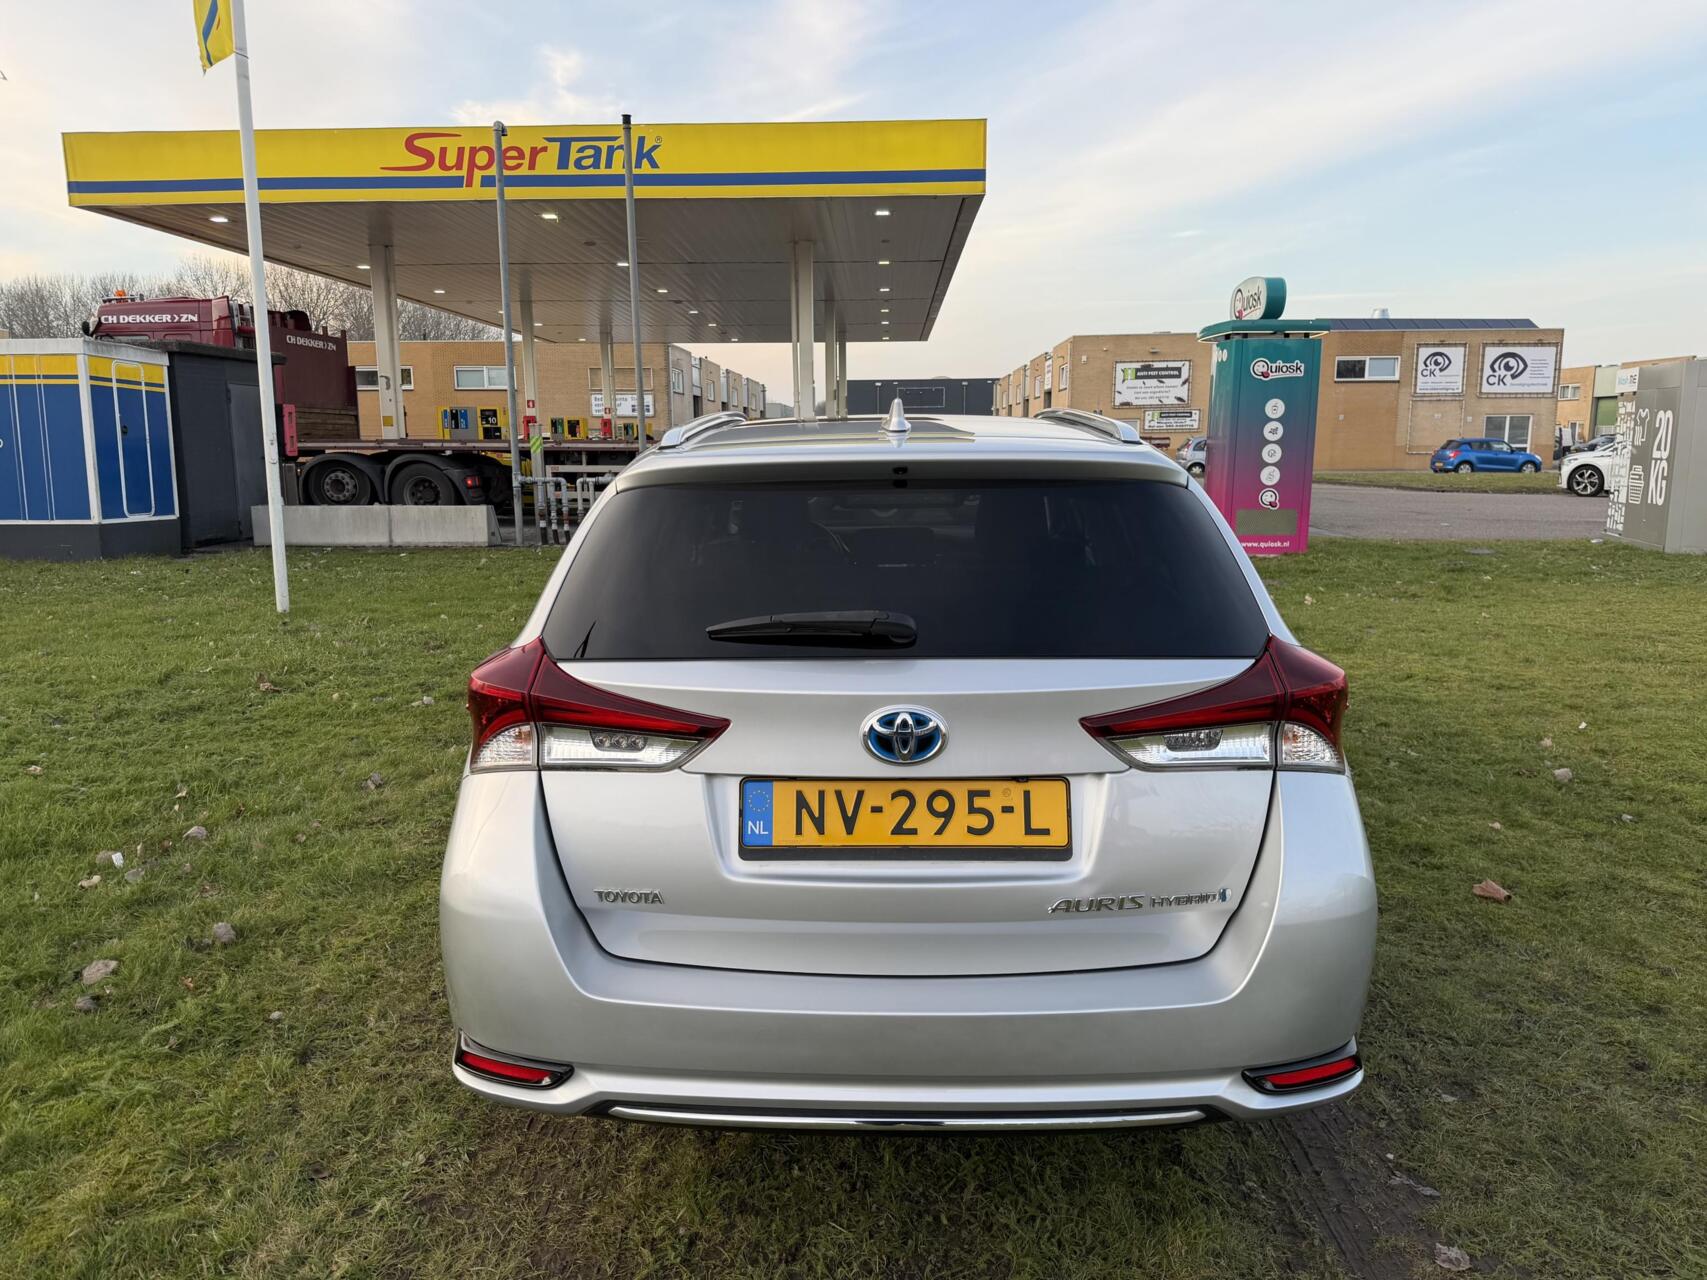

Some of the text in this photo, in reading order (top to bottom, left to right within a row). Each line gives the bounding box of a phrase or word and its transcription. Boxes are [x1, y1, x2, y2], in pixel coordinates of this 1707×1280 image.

[1234, 285, 1262, 320] Quiosk
[100, 314, 118, 324] CH
[120, 314, 172, 323] DEKKER
[286, 334, 296, 344] CH
[296, 336, 324, 349] DEKKER
[1251, 359, 1303, 379] Quiosk
[1420, 368, 1436, 378] CK
[1486, 374, 1508, 387] CK
[1652, 410, 1673, 460] 20
[1648, 459, 1667, 506] KG
[747, 789, 1051, 836] NL NV-295-L
[593, 888, 665, 905] TOYOTA
[1048, 892, 1218, 913] AURIS HYBRID
